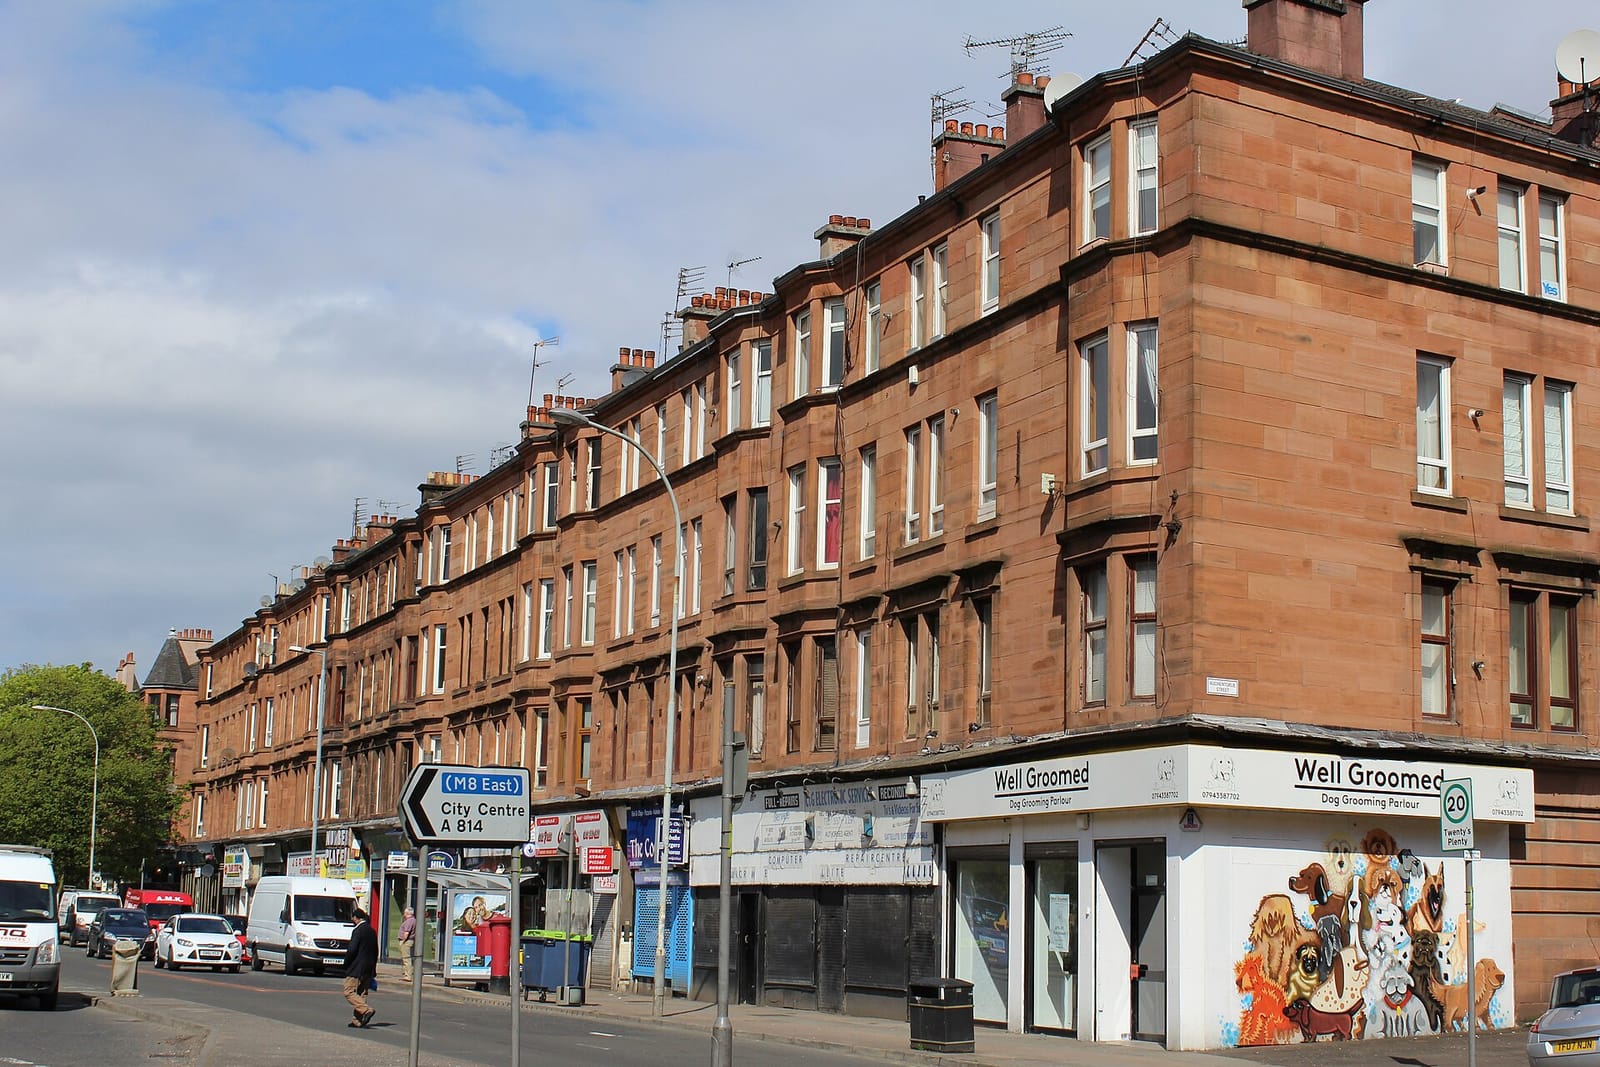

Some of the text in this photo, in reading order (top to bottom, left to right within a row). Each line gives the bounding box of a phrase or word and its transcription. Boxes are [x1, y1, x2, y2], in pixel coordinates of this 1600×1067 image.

[1542, 281, 1558, 296] Yes
[994, 760, 1089, 791] Well Groomed
[1294, 757, 1444, 790] Well Groomed
[445, 774, 519, 794] (M8 East)
[1201, 791, 1240, 800] 07943387702
[1321, 793, 1420, 810] Dog Grooming Parlour
[441, 801, 525, 818] City Centre
[1009, 796, 1072, 811] Dog Grooming Parlour
[1446, 795, 1465, 812] 20
[440, 819, 483, 832] A 814
[1443, 827, 1472, 837] Twenty's
[629, 837, 643, 858] The
[1447, 837, 1468, 846] Plenty
[768, 854, 803, 865] COMPUTER
[1558, 1042, 1575, 1052] TF07
